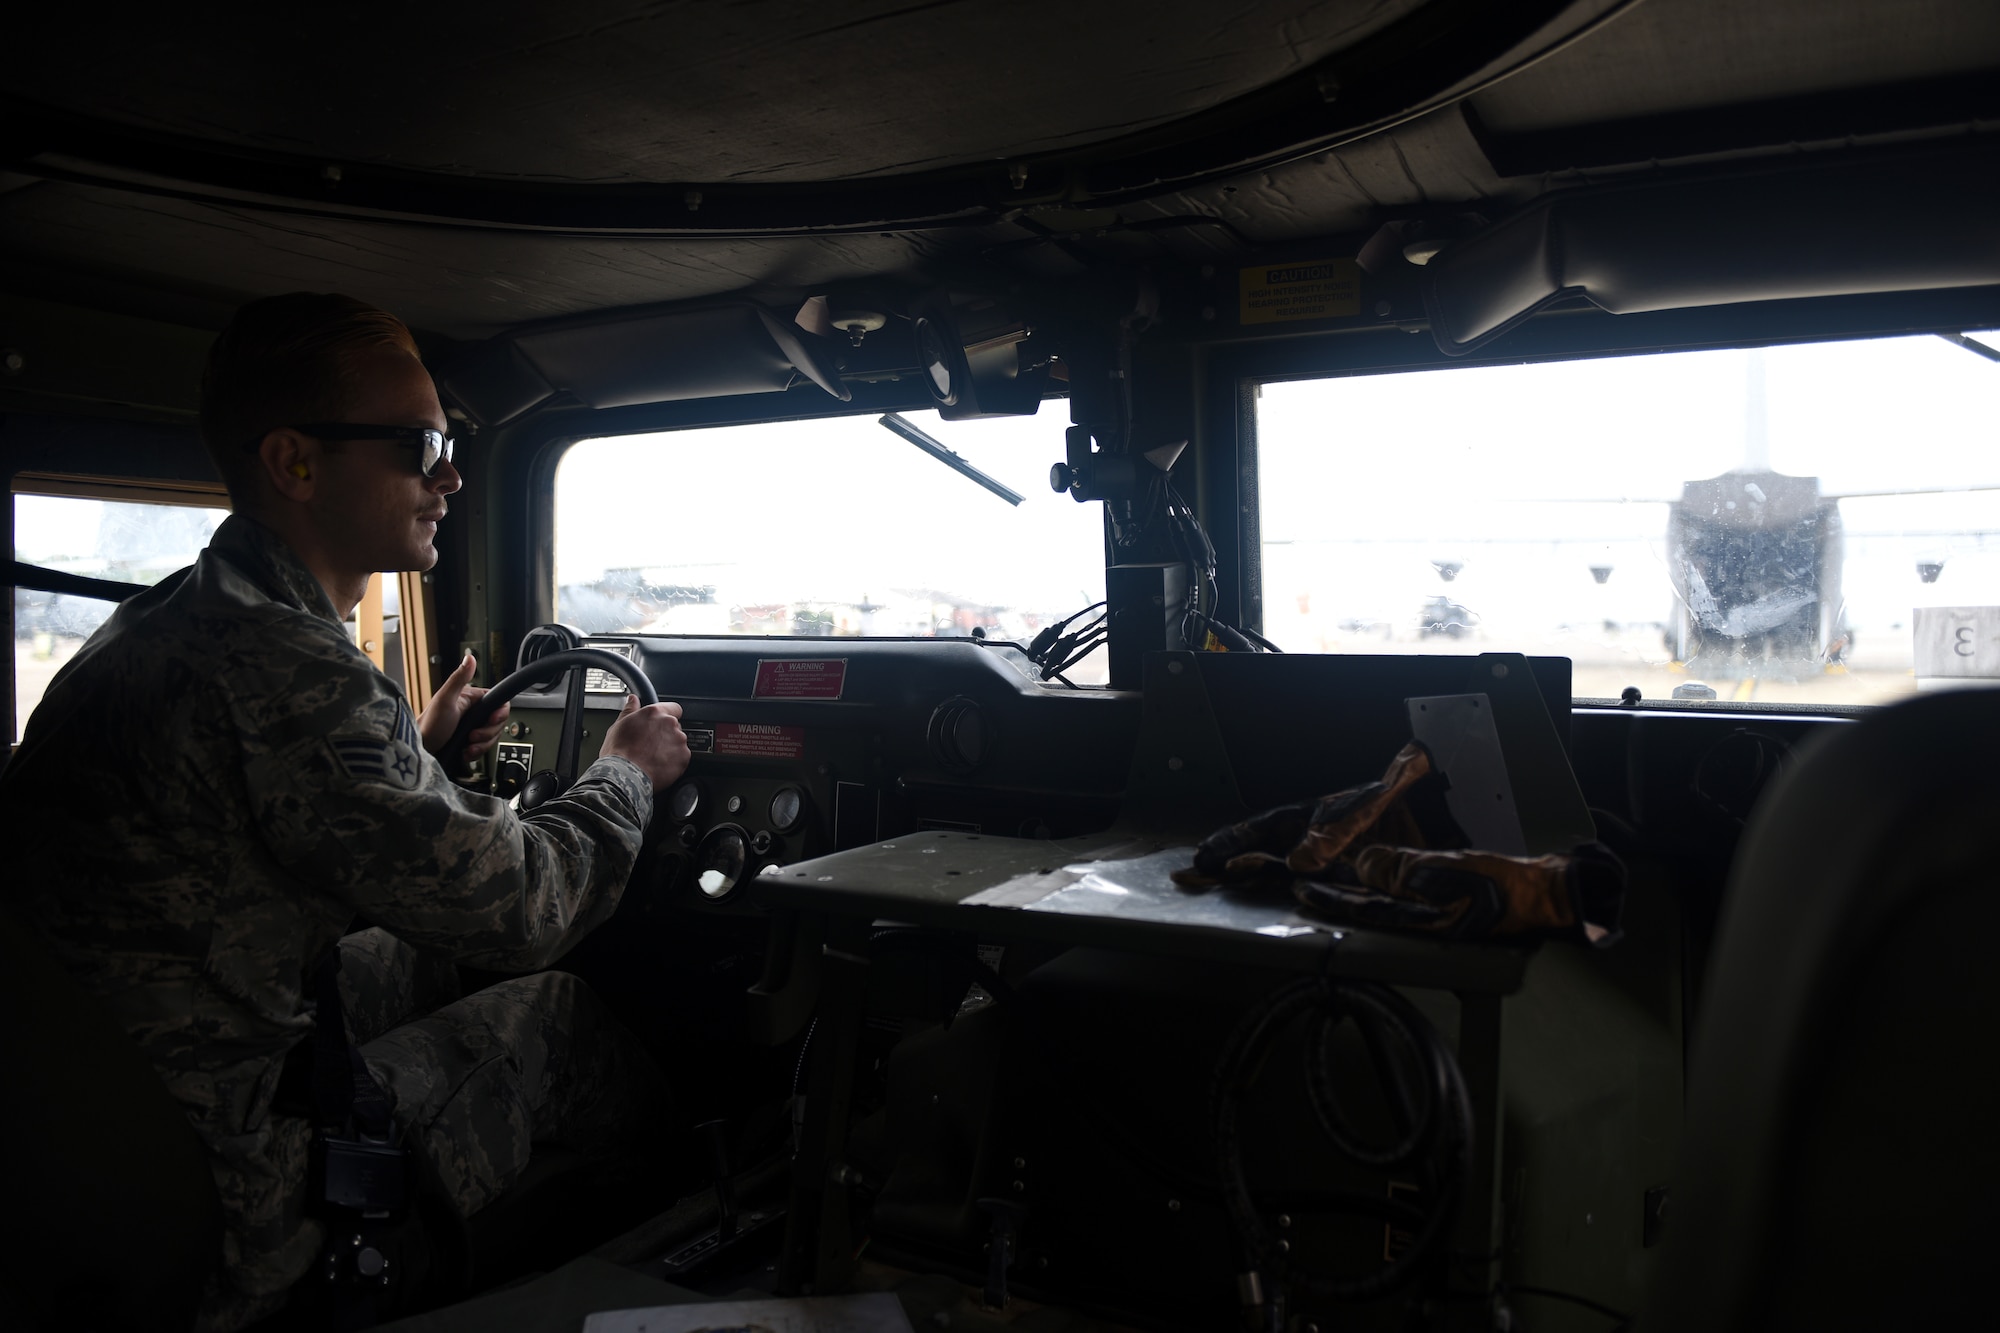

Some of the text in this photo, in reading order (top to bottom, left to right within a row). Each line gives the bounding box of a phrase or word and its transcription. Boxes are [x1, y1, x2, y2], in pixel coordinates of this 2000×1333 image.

[1270, 267, 1330, 282] CAUTION
[1248, 280, 1353, 298] HIGH INTENSITY NOISE
[1248, 291, 1354, 308] HEARING PROTECTION
[1276, 305, 1326, 316] REQUIRED
[789, 662, 825, 670] WARNING
[738, 724, 781, 735] WARNING
